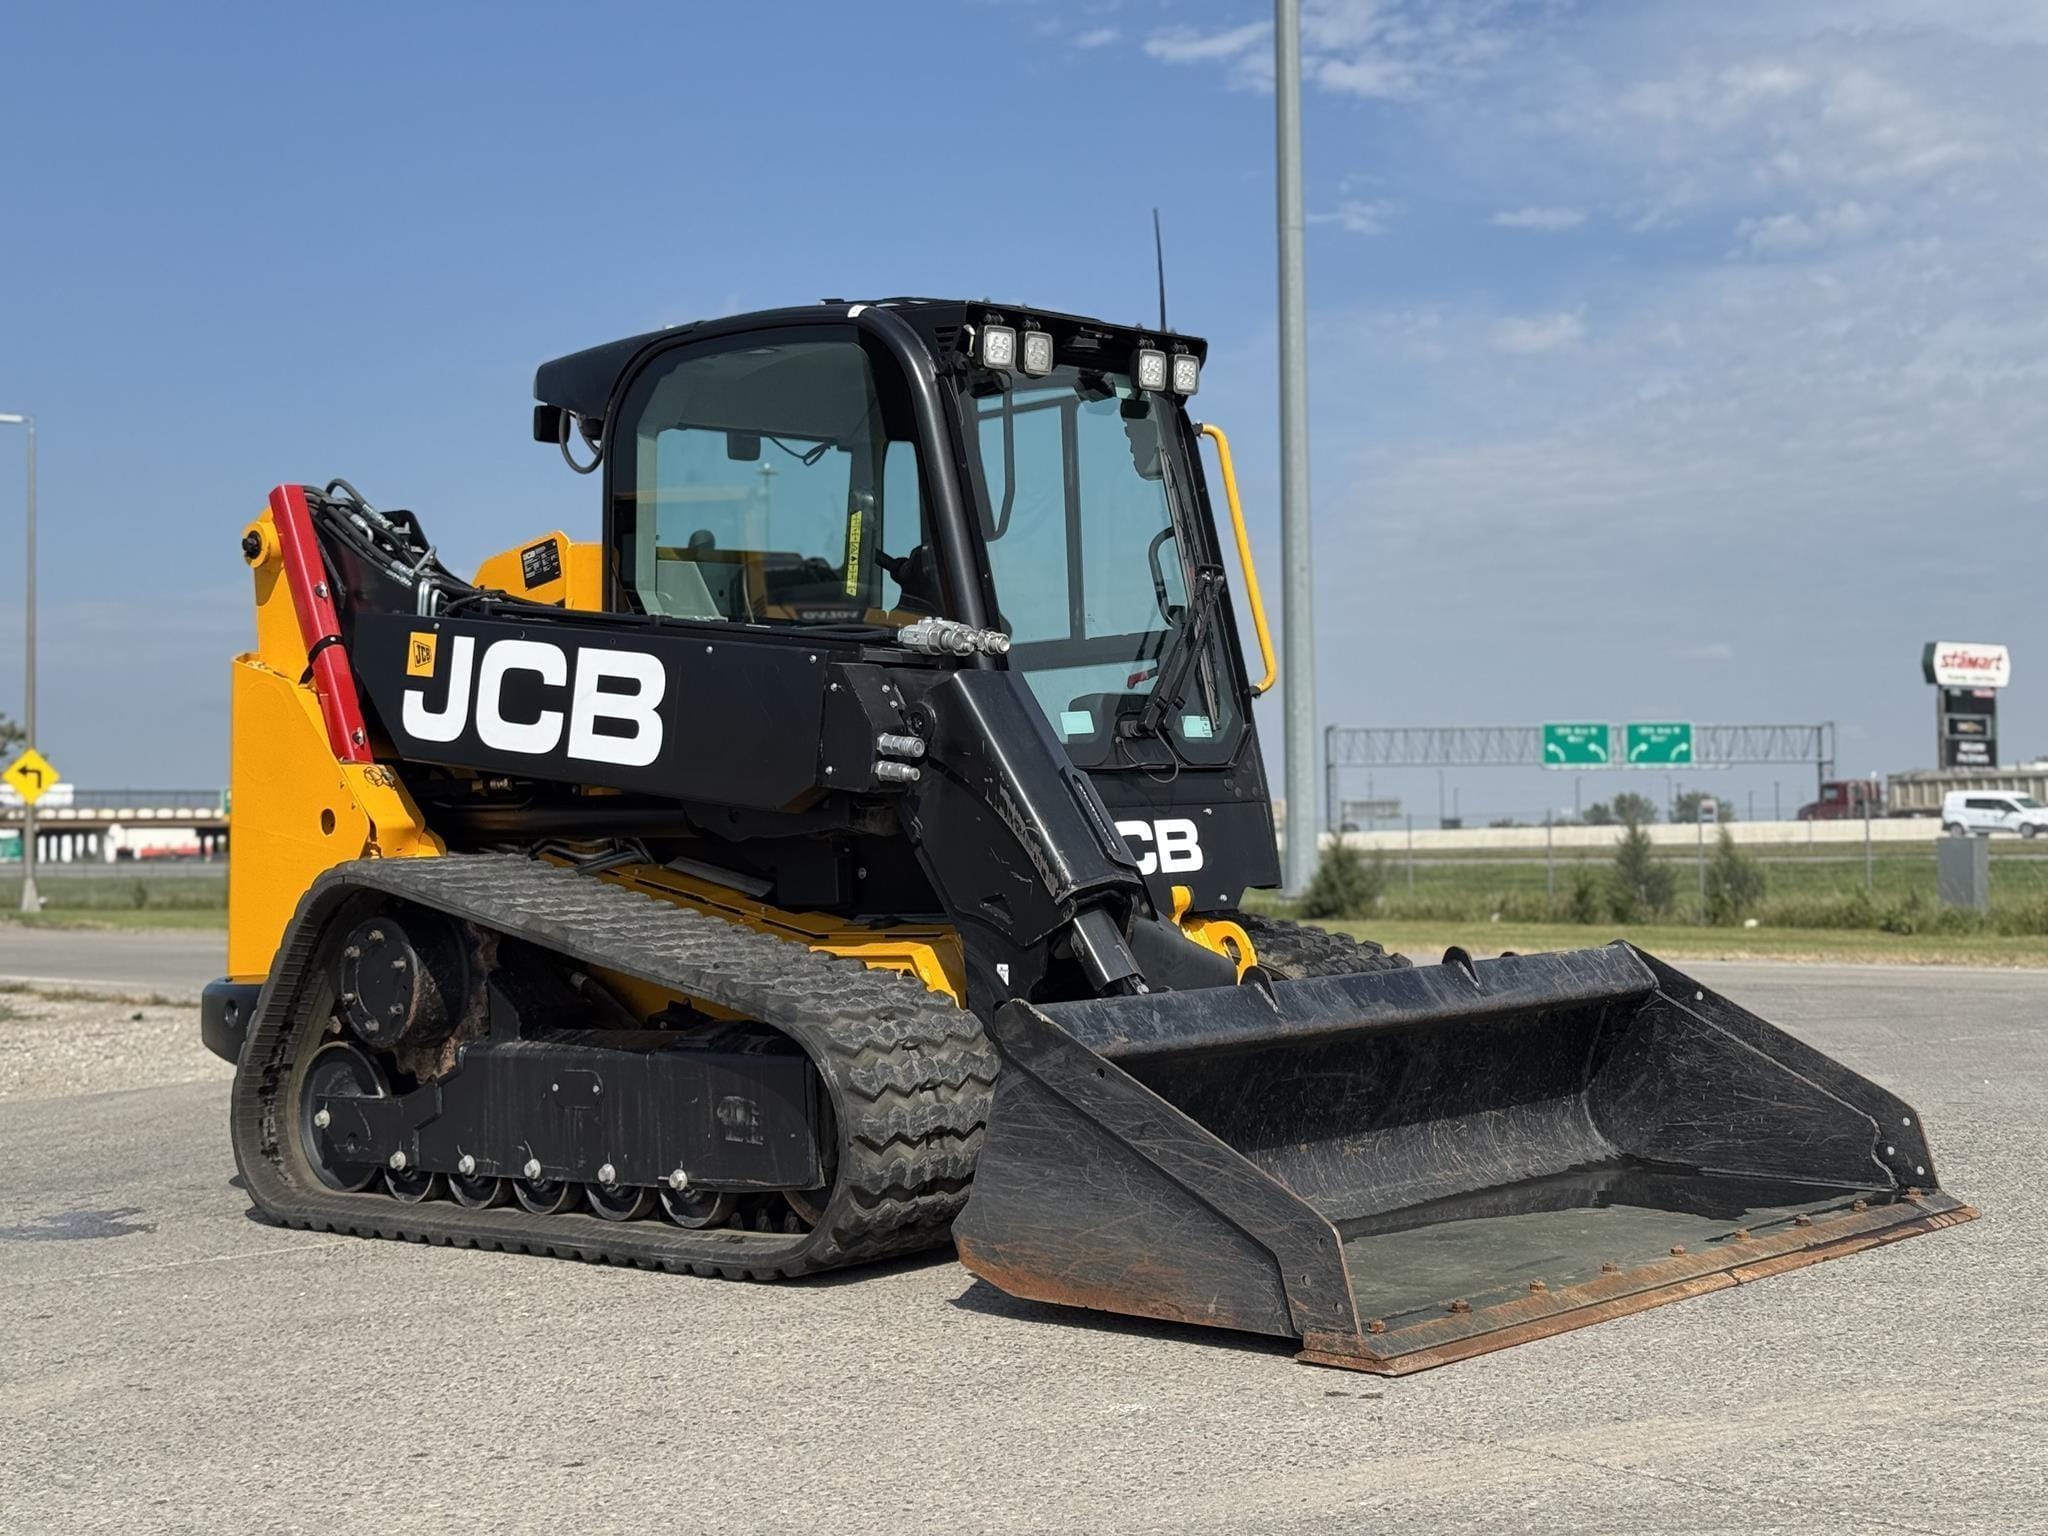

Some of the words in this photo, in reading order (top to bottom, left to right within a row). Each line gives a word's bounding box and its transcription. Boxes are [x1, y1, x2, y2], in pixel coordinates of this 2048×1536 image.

[416, 644, 432, 664] JCB
[402, 635, 666, 767] JCB
[1114, 818, 1204, 876] CB
